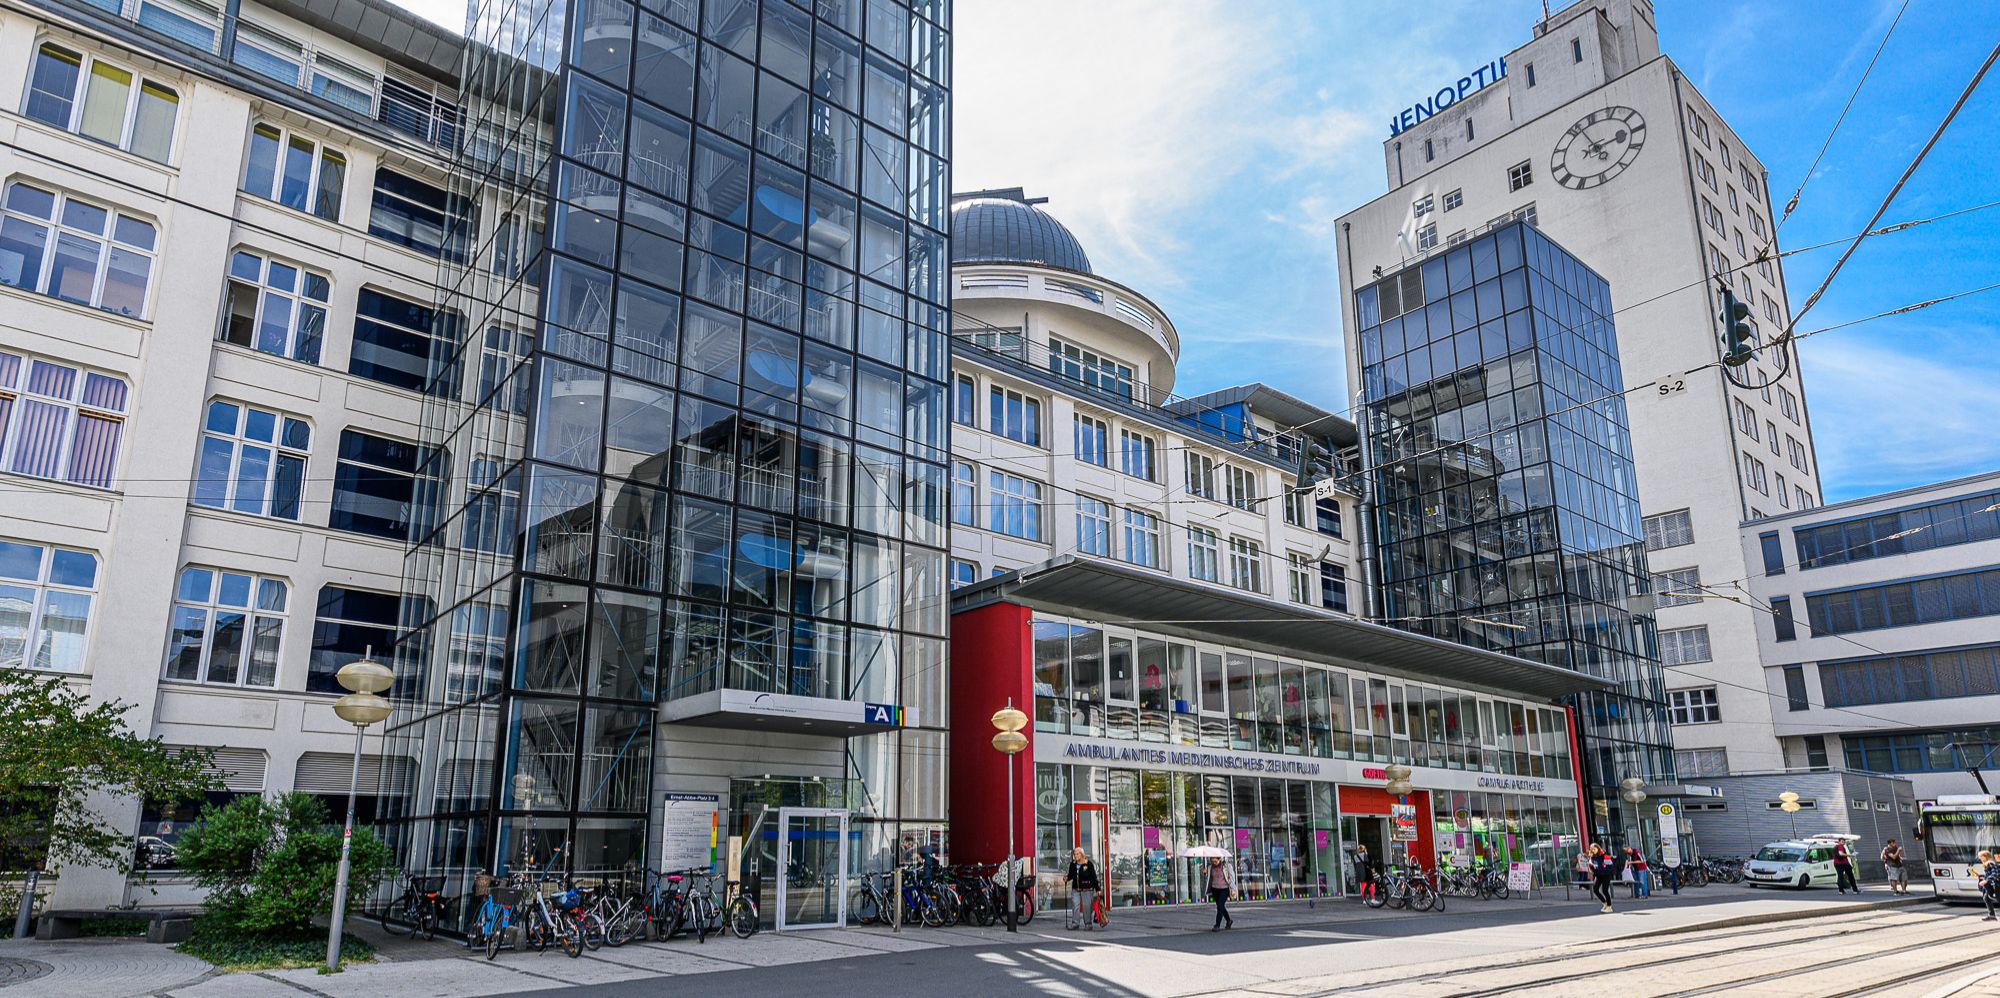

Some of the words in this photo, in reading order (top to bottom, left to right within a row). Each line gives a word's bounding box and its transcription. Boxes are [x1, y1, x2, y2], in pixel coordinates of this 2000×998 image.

[1659, 380, 1684, 395] S-2
[1317, 485, 1331, 496] S-1
[874, 706, 890, 723] A
[1064, 743, 1167, 763] AMBULANTES
[1169, 751, 1264, 771] MEDIZINISCHES
[1266, 759, 1320, 775] ZENTRUM
